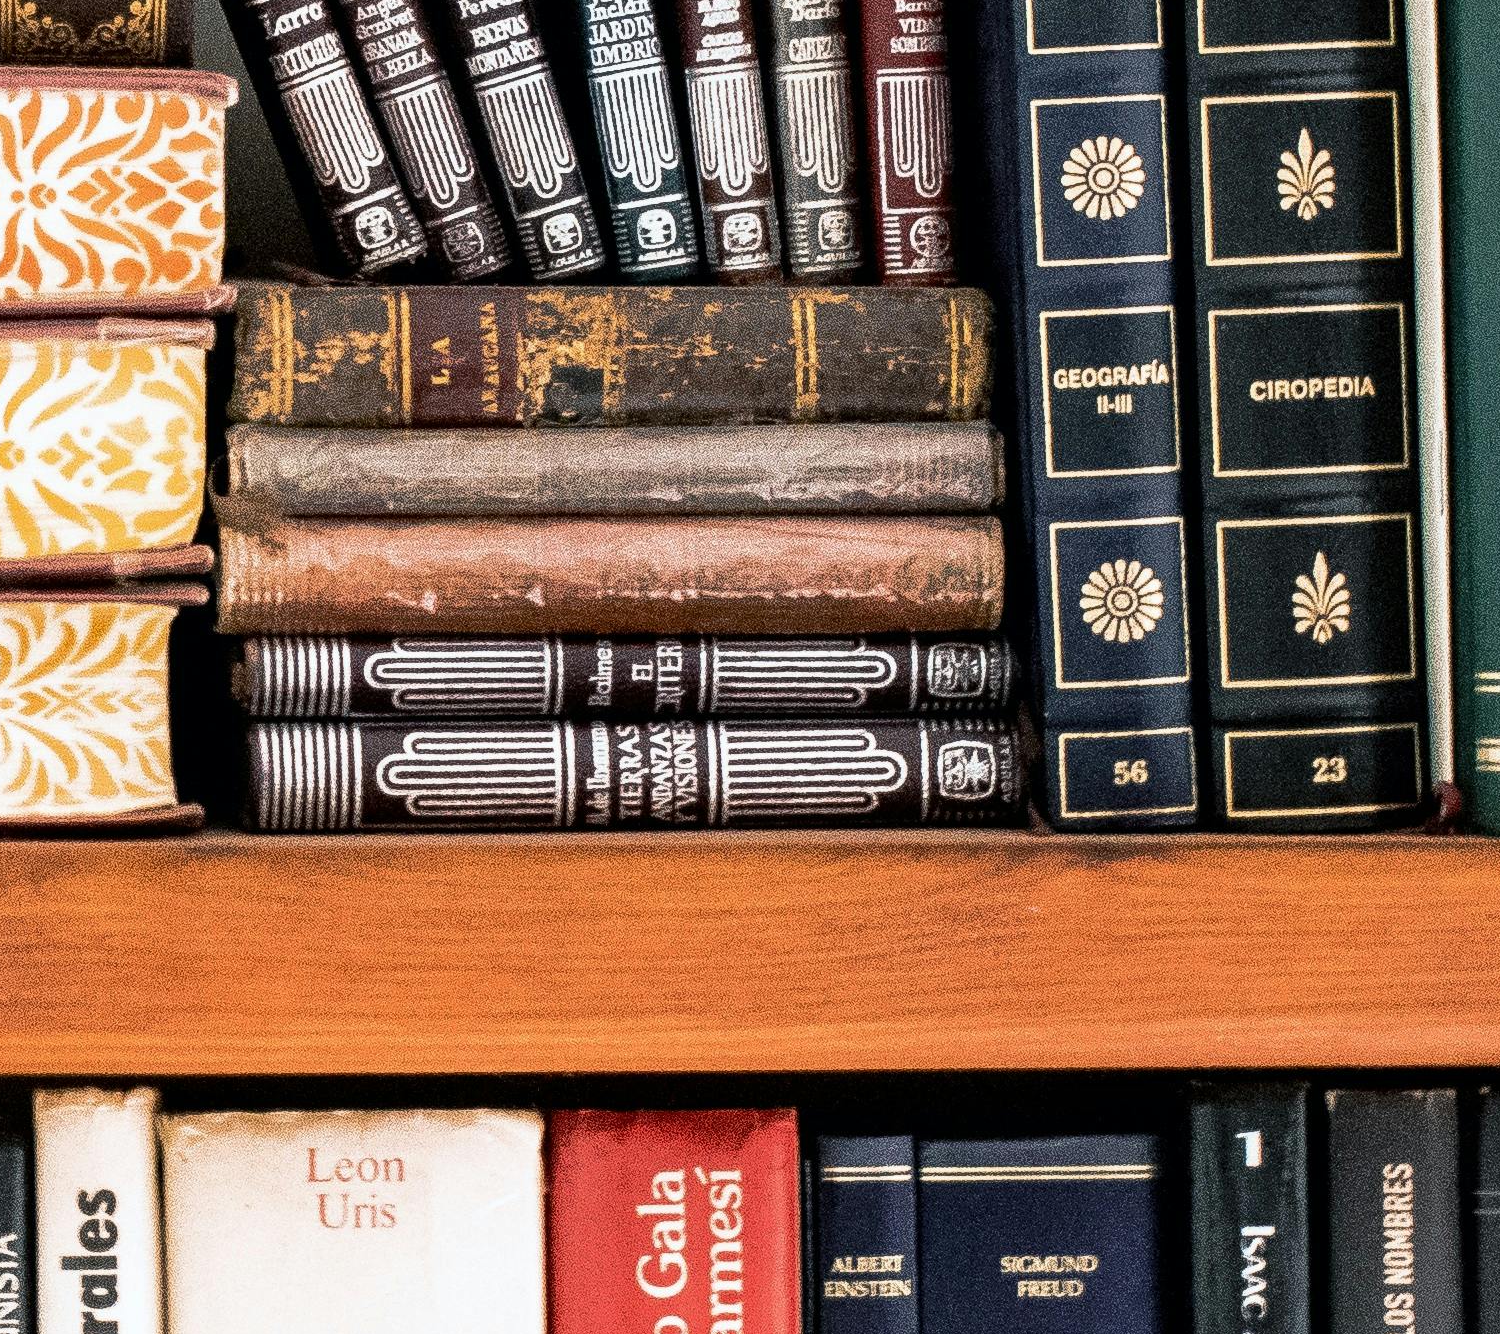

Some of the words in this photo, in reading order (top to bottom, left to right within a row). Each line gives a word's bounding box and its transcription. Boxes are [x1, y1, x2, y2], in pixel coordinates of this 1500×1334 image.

[1053, 359, 1169, 389] GEOGRAFÍA
[1249, 376, 1375, 402] CIROPEDIA
[1097, 394, 1133, 414] II-III
[1114, 759, 1149, 785] 56
[1312, 756, 1347, 783] 23
[306, 1146, 405, 1183] Leon
[317, 1192, 396, 1229] Uris
[636, 1170, 688, 1299] Gala
[1383, 1163, 1414, 1285] NOMBRES
[1000, 1254, 1099, 1273] SIGMUND
[825, 1279, 912, 1298] EINSTEIN
[1017, 1279, 1084, 1298] FREUD
